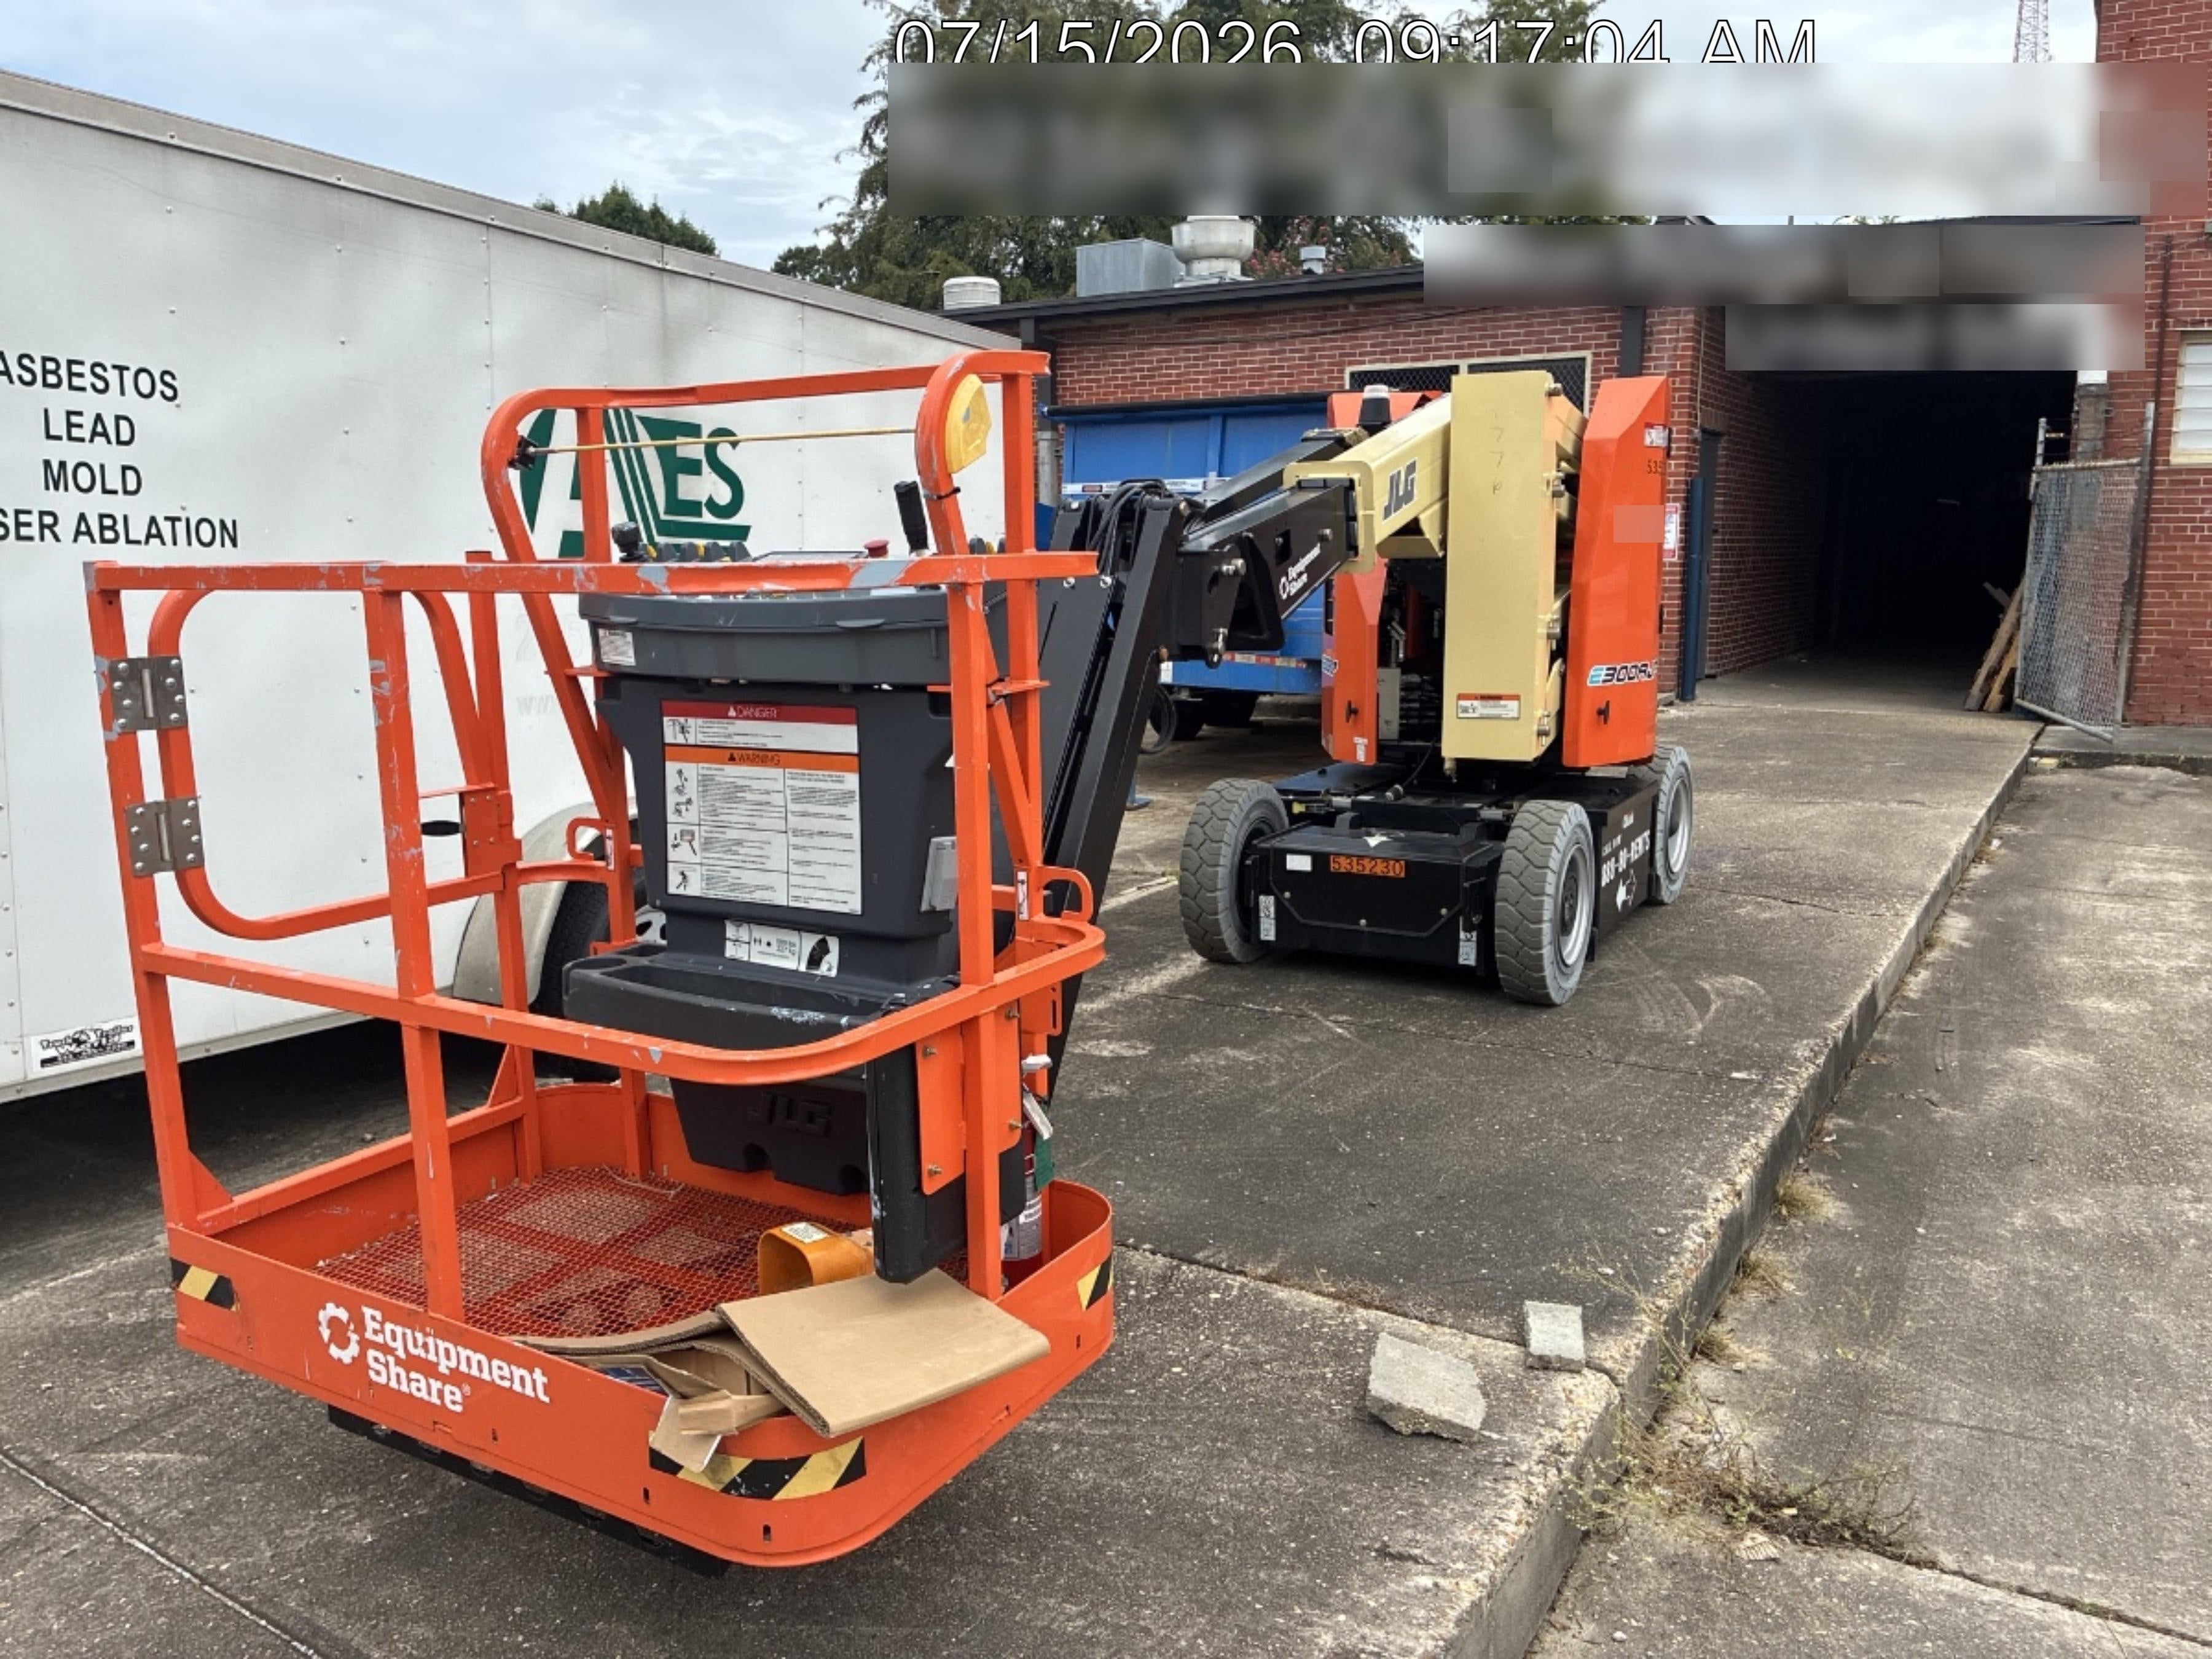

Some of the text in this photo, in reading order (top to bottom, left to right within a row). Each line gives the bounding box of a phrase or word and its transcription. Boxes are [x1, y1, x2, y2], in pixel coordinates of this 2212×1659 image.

[0, 350, 178, 402] ASBESTOS
[44, 407, 135, 446] LEAD
[42, 459, 142, 496] MOLD
[1382, 458, 1416, 521] JLG
[73, 512, 238, 547] ABLATION
[737, 707, 777, 719] DANGER
[737, 753, 781, 766] WARNING
[1332, 856, 1403, 876] 535230
[361, 1305, 550, 1403] Equipment
